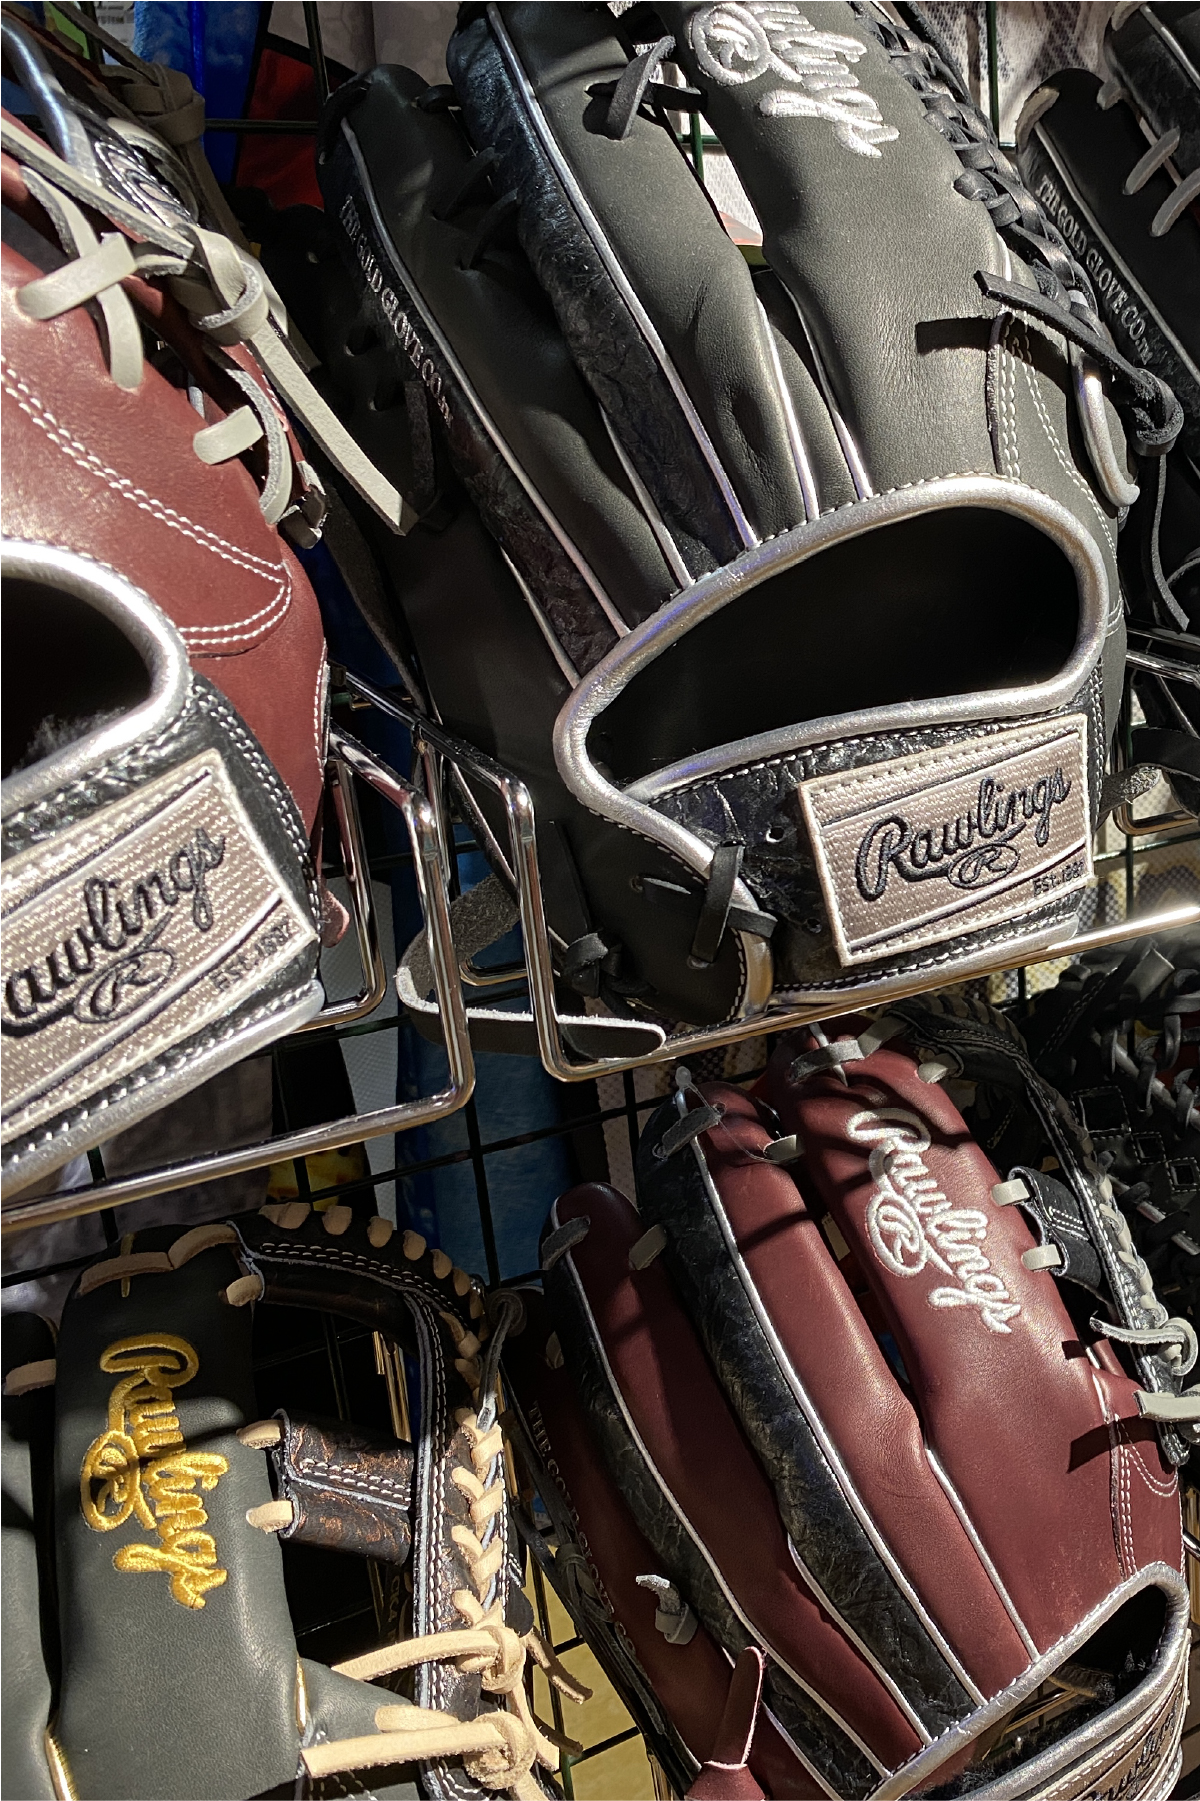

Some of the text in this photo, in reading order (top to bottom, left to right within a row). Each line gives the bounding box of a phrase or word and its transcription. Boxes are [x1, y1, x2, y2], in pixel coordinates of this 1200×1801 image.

[740, 2, 900, 158] wlings
[1057, 206, 1087, 256] GOLD
[1086, 250, 1130, 314] GLOVE
[856, 767, 1071, 901] Rawlings
[0, 827, 226, 1037] awlings
[846, 1107, 1022, 1335] Rawlings
[98, 1332, 230, 1610] Rawlings
